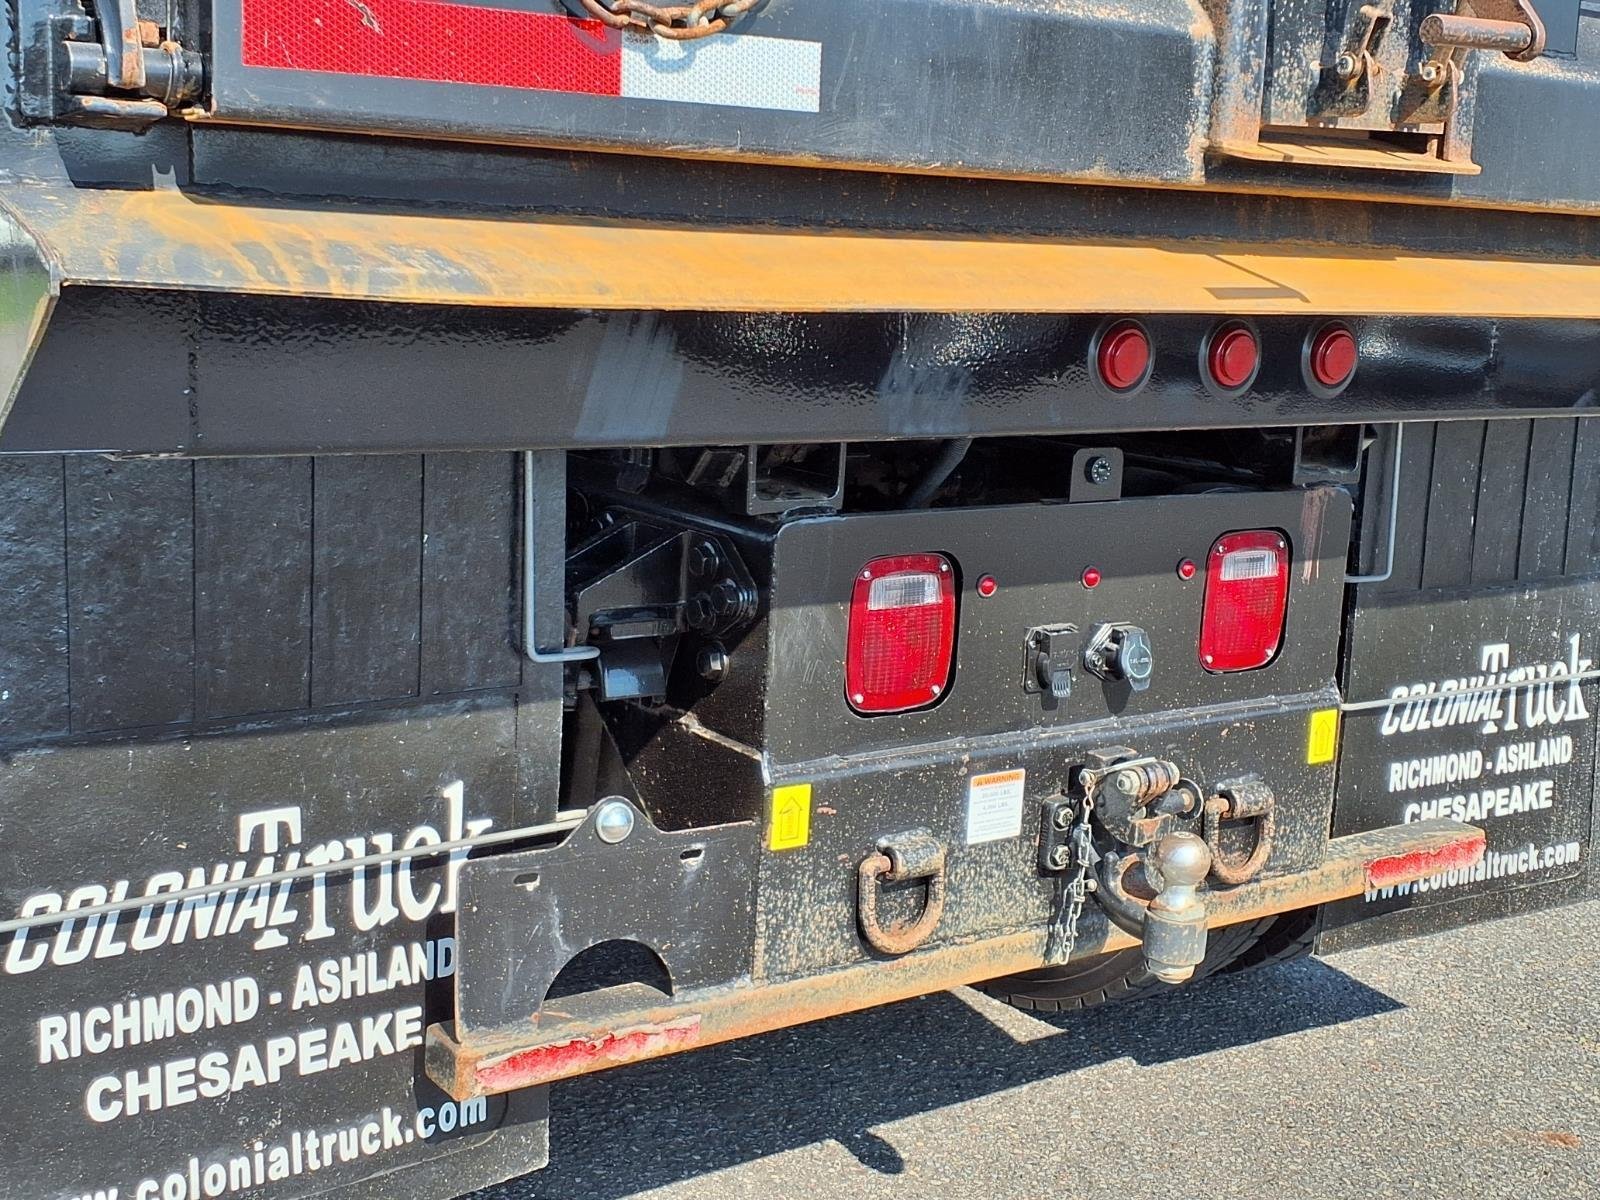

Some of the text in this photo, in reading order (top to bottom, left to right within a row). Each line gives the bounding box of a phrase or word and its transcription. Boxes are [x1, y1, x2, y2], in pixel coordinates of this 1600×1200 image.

[1381, 632, 1592, 736] COLONIAL Truck
[985, 773, 1020, 786] WARNING
[1389, 735, 1573, 792] RICHMOND - ASHLAND
[1404, 780, 1554, 825] CHESAPEAKE
[4, 780, 493, 975] COLONIAL Truck
[38, 937, 456, 1065] RICHMOND - ASHLAND
[85, 1006, 424, 1123] CHESAPEAKE
